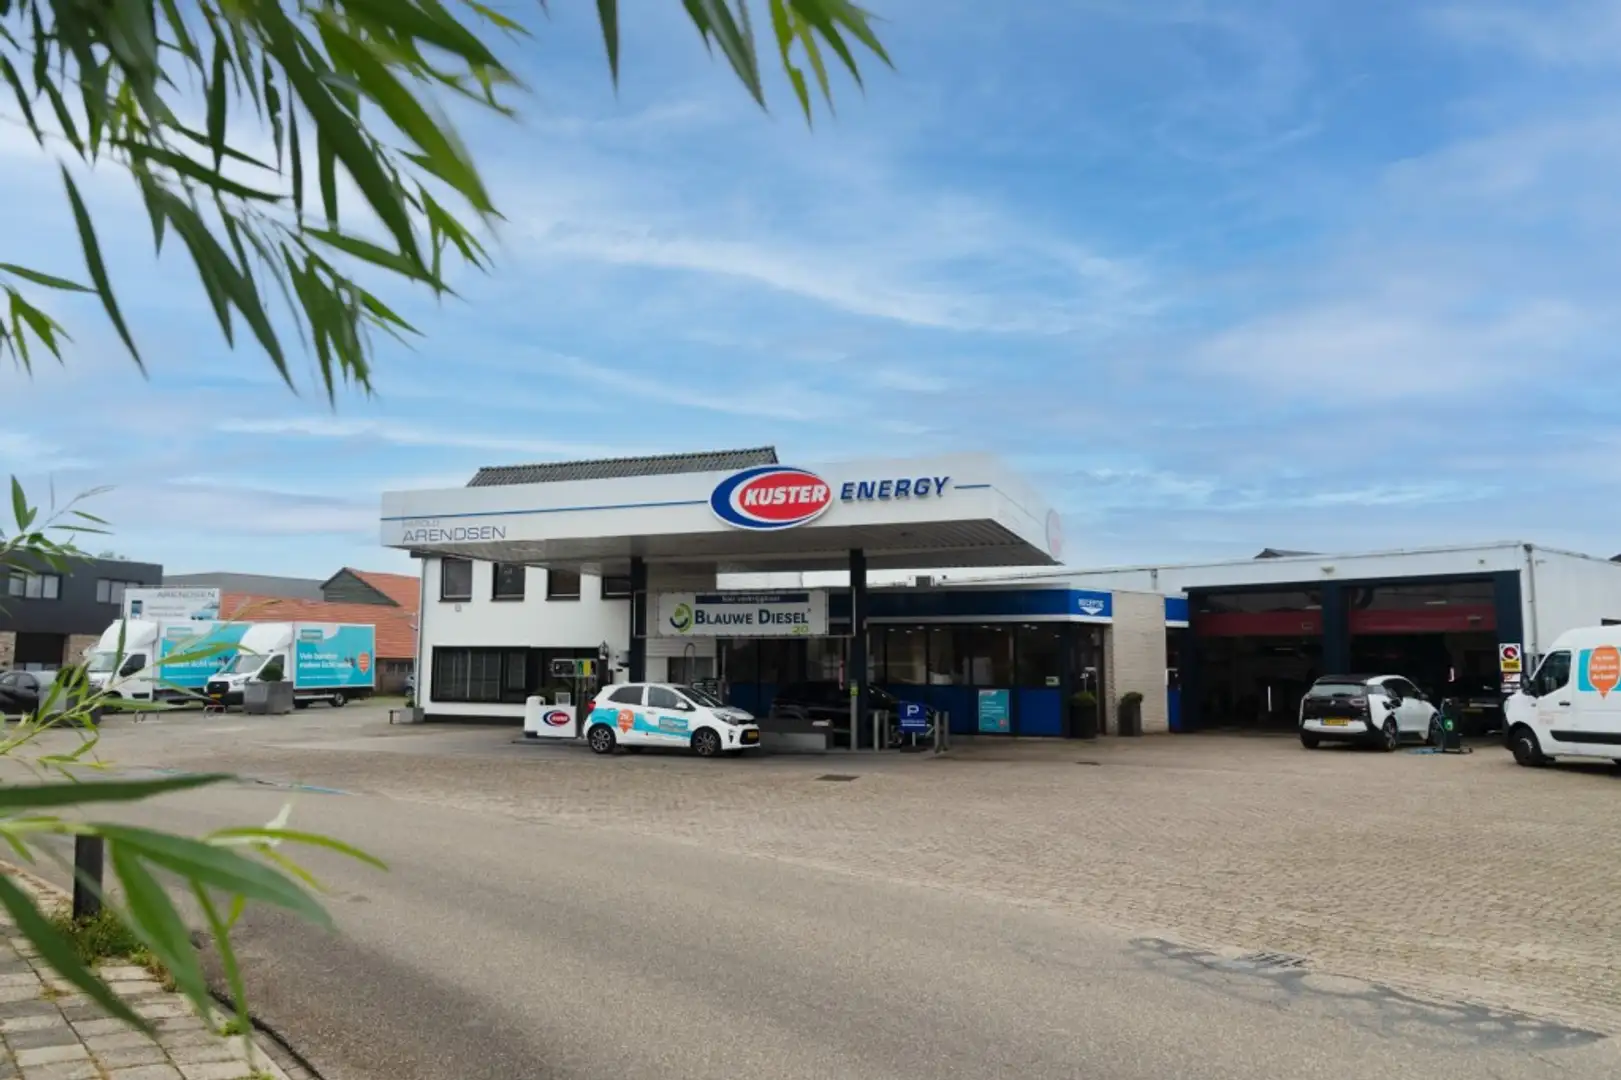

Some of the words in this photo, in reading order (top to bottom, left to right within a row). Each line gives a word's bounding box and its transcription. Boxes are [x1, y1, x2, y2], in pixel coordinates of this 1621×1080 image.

[744, 484, 827, 506] KUSTER
[840, 476, 950, 502] ENERGY
[402, 525, 506, 544] ARENDSEN
[694, 608, 753, 626] BLAUWE
[906, 704, 920, 717] P
